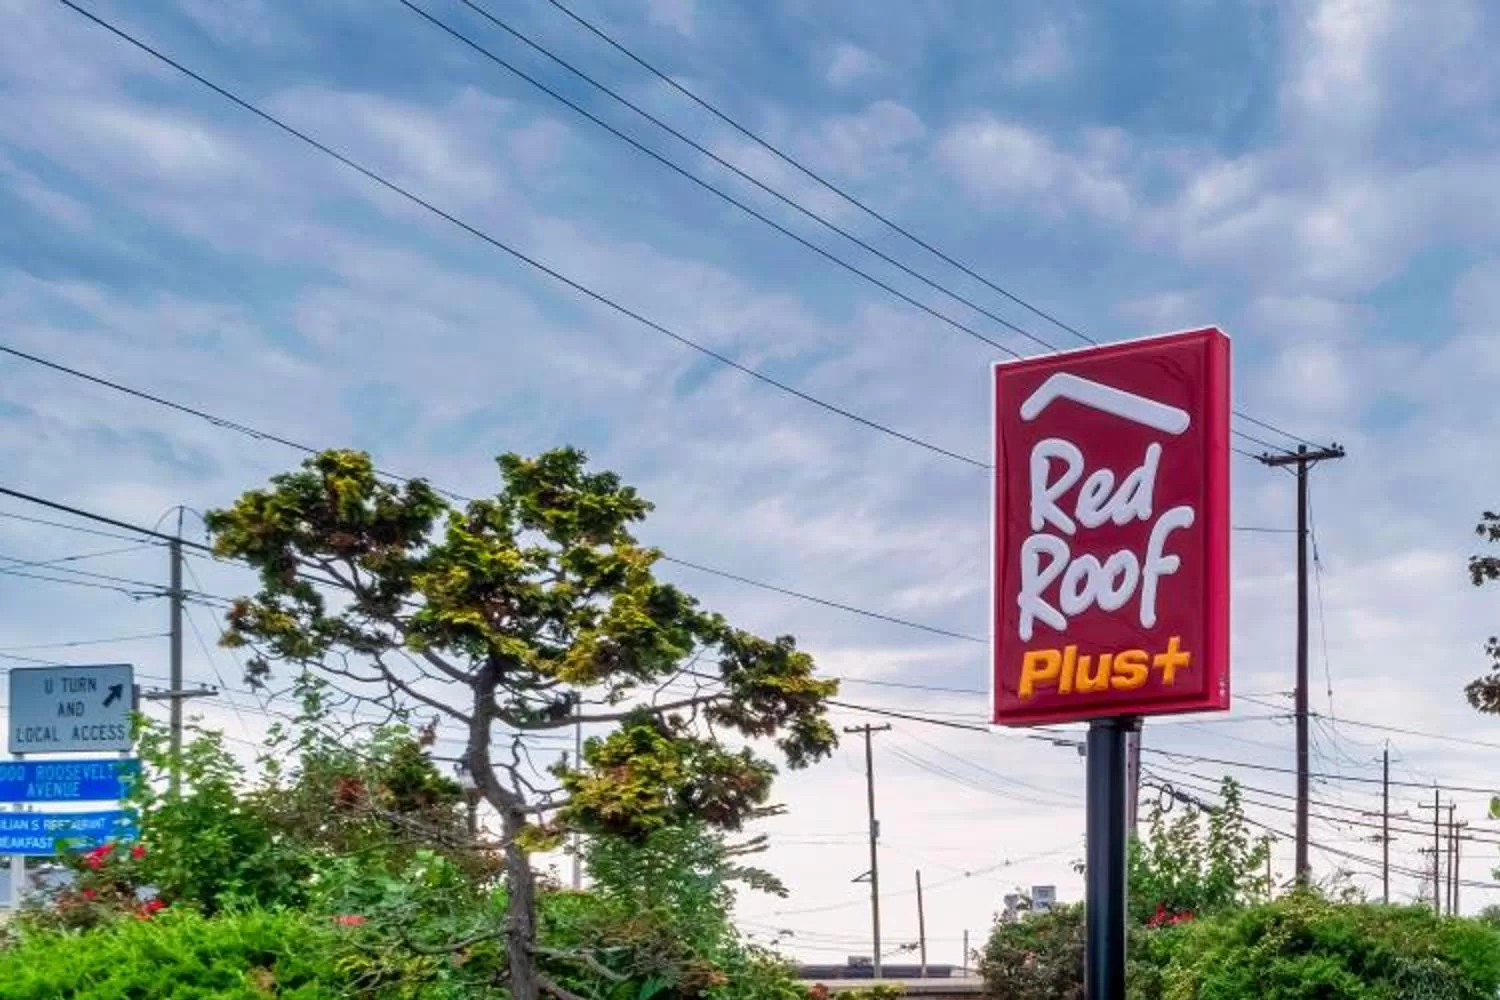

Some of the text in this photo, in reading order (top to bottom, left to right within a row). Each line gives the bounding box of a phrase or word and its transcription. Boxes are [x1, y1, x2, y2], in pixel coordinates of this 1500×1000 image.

[1030, 437, 1162, 535] Red
[1017, 505, 1194, 642] Roof
[1018, 635, 1192, 698] Plus+
[44, 676, 97, 695] U TURN
[57, 700, 85, 718] AND
[16, 723, 126, 743] LOCAL ACCESS
[35, 762, 113, 781] ROOSEVELT
[26, 781, 80, 798] AVENUE
